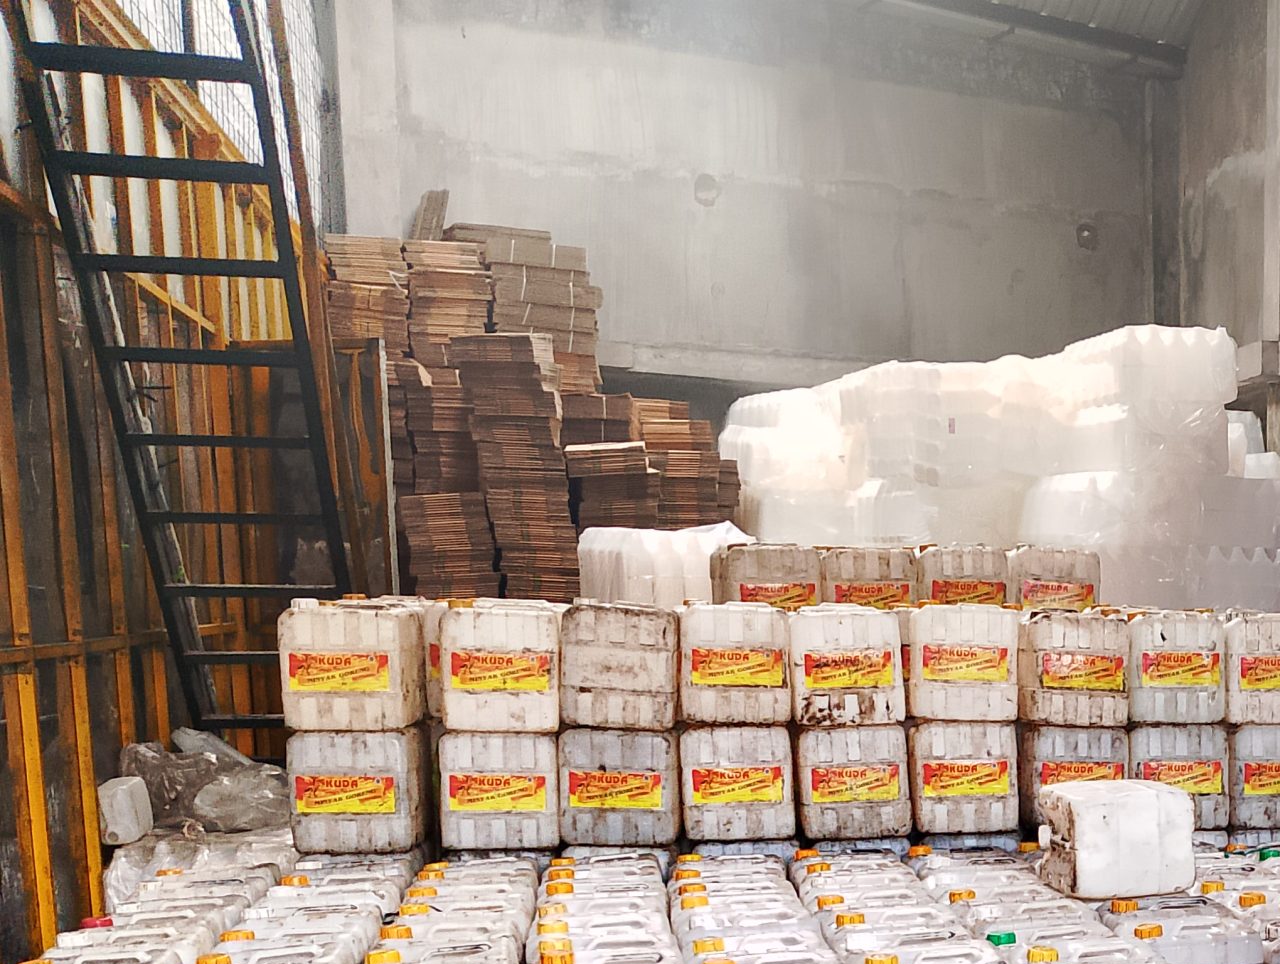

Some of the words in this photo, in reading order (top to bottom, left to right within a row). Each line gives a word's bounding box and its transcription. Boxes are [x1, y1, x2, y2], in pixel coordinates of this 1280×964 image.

[720, 651, 749, 661] KUDA
[949, 649, 977, 658] KUDA
[319, 657, 351, 666] KUDA
[481, 656, 513, 665] KUDA
[949, 765, 978, 773] KUDA
[1066, 766, 1093, 774] KUDA
[1167, 764, 1193, 772] KUDA
[721, 770, 749, 779] KUDA
[838, 769, 867, 778] KUDA
[326, 779, 358, 788] KUDA
[479, 778, 510, 786] KUDA
[597, 776, 628, 785] KUDA
